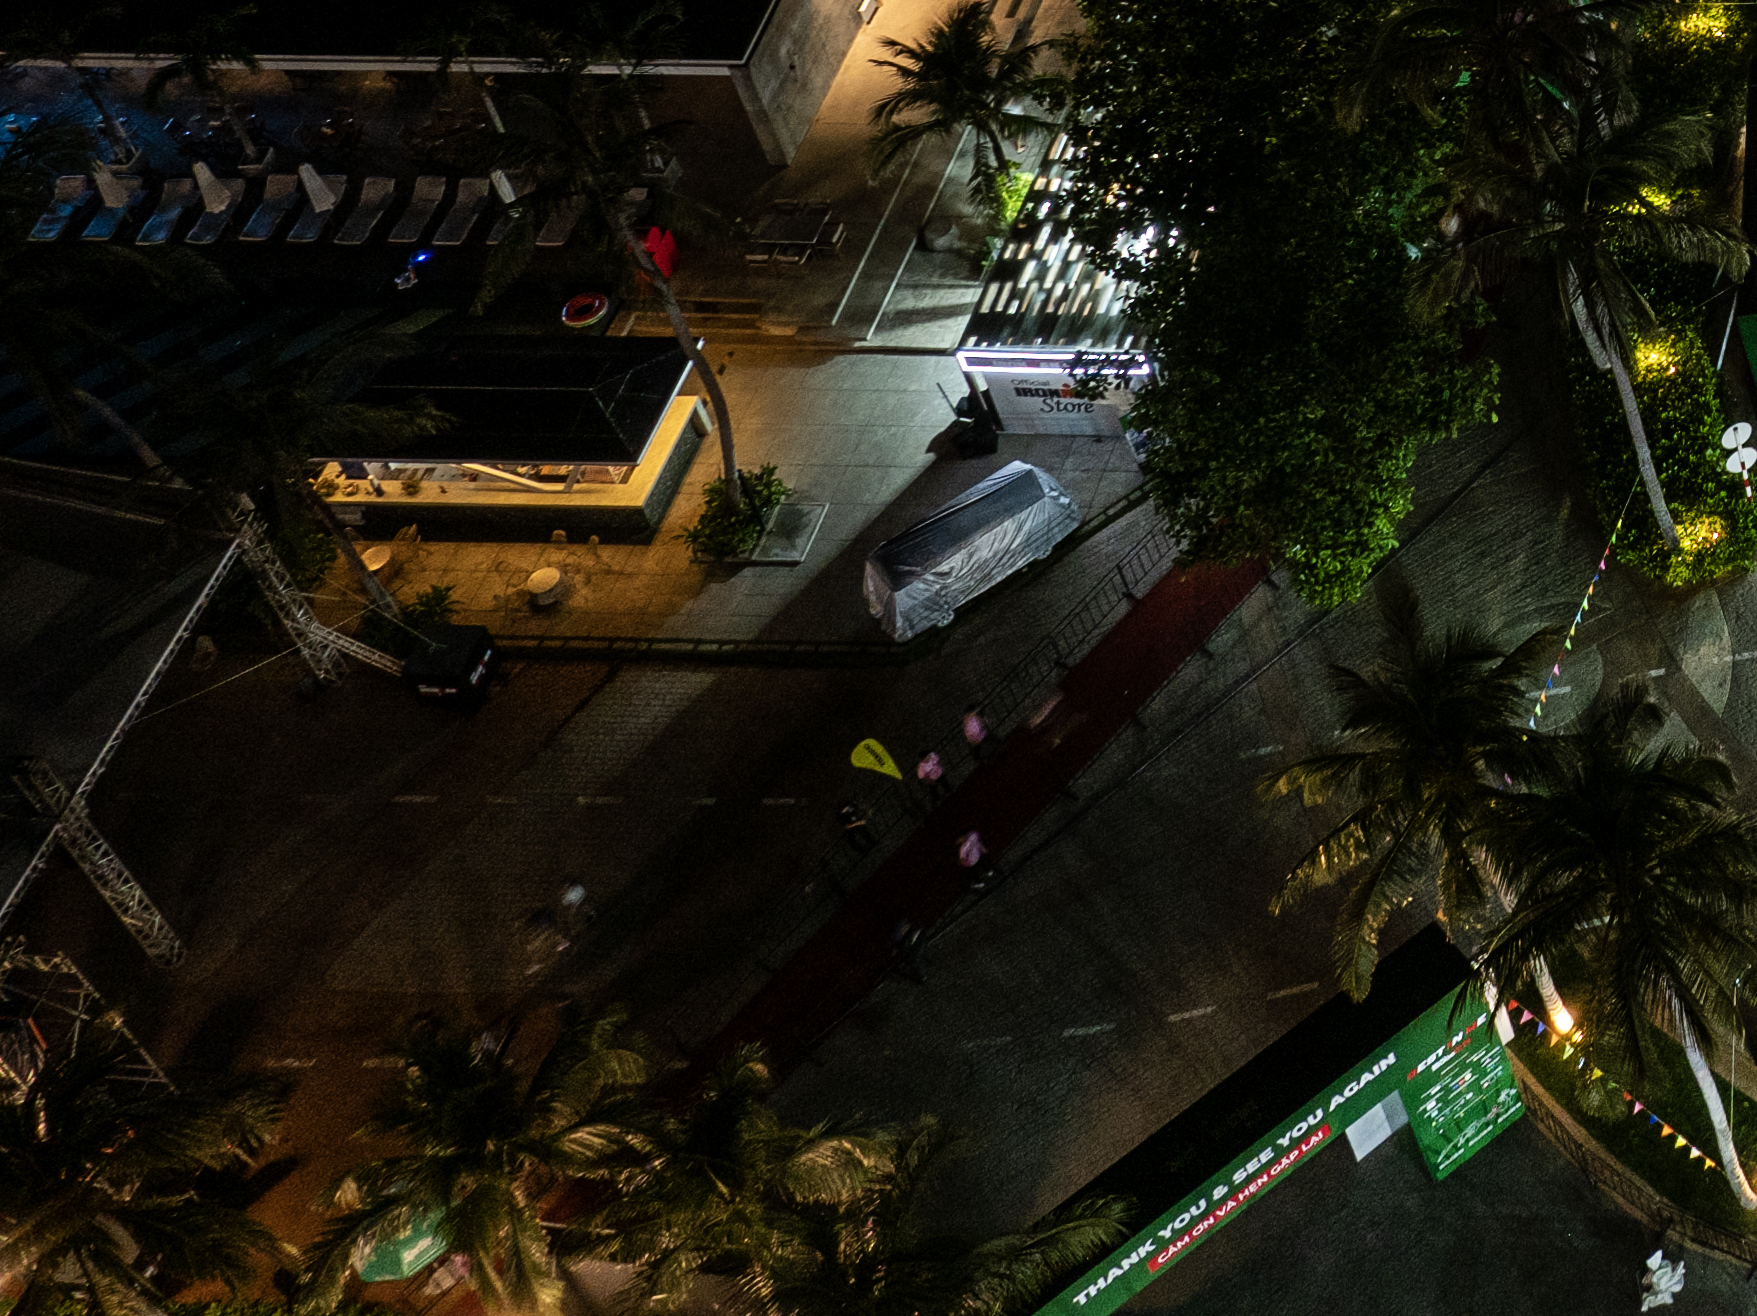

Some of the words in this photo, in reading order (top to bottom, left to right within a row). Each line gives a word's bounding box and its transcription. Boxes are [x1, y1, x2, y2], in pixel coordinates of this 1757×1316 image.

[1011, 379, 1051, 387] Official
[1040, 398, 1095, 414] Store
[1072, 1238, 1157, 1307] THANK
[1157, 1198, 1207, 1240] YOU
[1212, 1184, 1229, 1201] &
[1232, 1146, 1275, 1185] SEE
[1276, 1107, 1324, 1148] YOU
[1328, 1052, 1398, 1114] AGAIN
[1238, 1174, 1269, 1201] HẸN
[1301, 1131, 1324, 1152] LẠI
